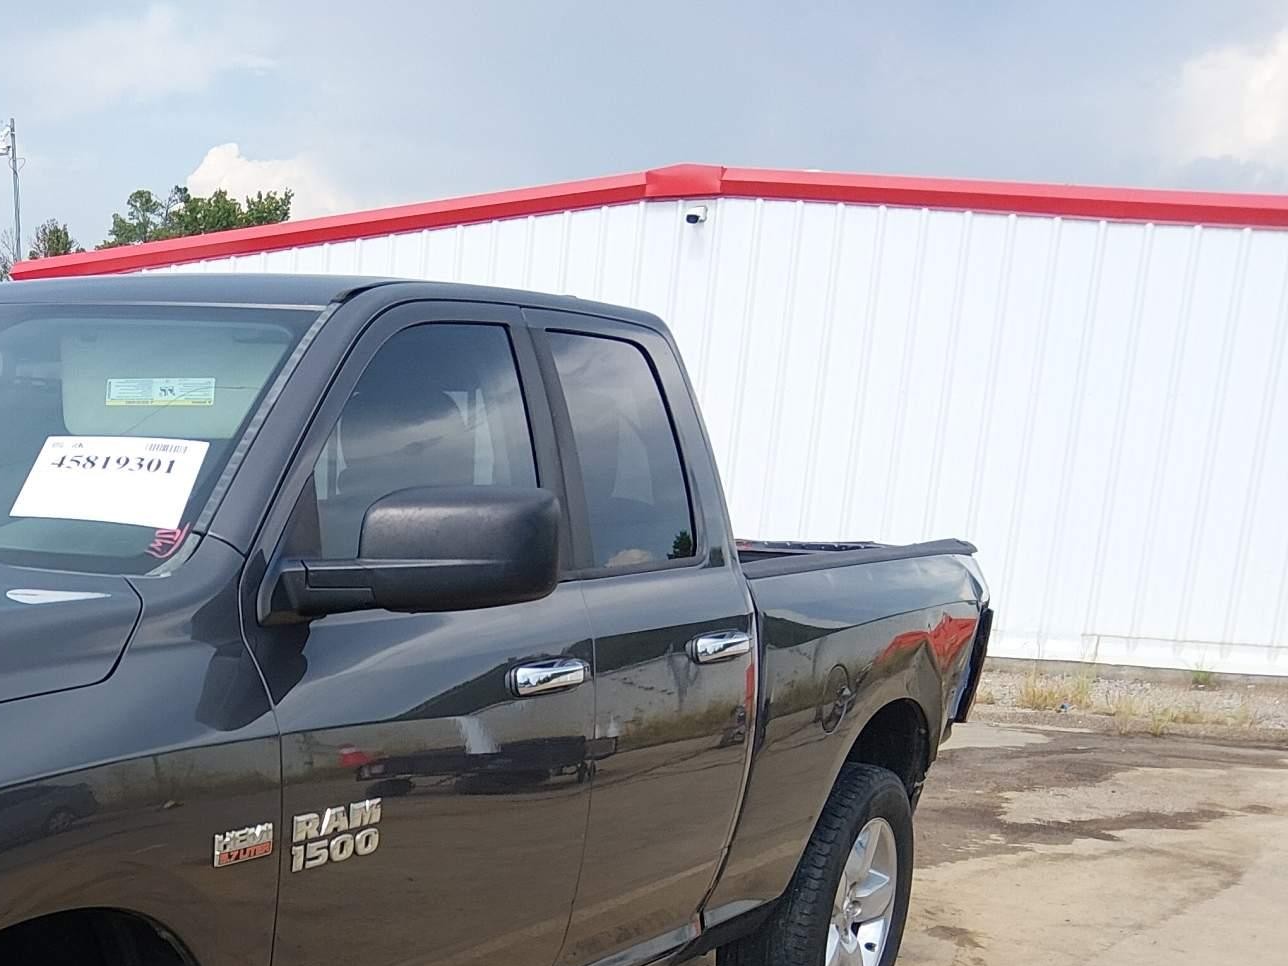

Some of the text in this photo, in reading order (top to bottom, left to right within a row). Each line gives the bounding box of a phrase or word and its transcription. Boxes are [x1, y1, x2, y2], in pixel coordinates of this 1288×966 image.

[51, 455, 176, 474] 45819301
[214, 822, 273, 852] HEMI
[292, 797, 383, 843] RAM
[291, 827, 381, 873] 1500
